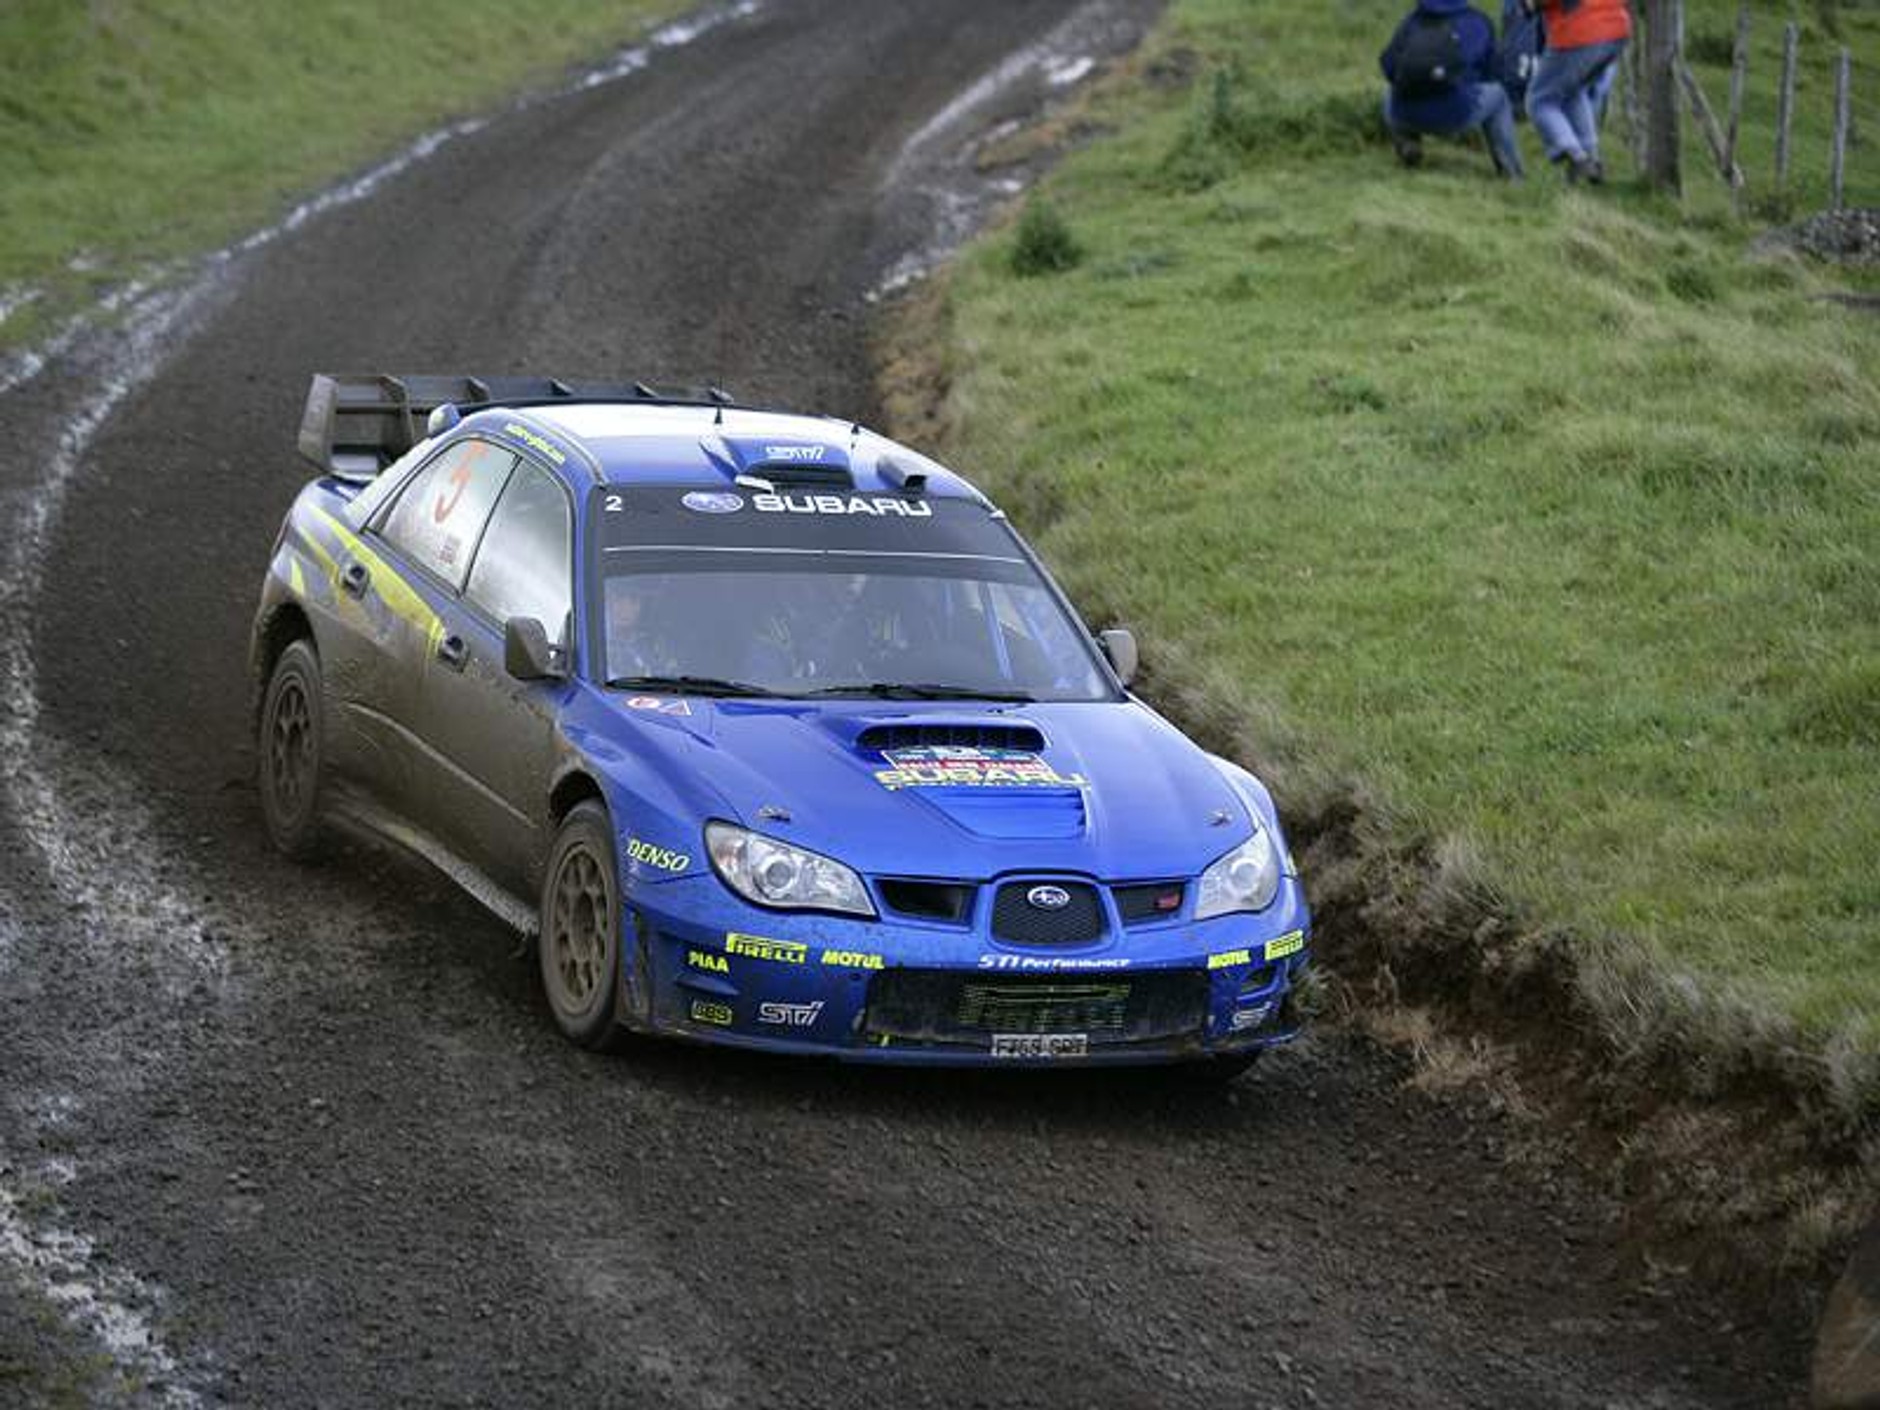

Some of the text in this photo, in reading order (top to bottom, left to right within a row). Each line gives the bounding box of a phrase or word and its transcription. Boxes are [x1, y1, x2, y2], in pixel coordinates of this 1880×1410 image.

[605, 497, 622, 512] 2
[752, 495, 931, 517] SUBARU
[626, 839, 690, 871] DENSO
[726, 933, 808, 963] PIRELLI
[688, 951, 730, 973] PIAA
[821, 950, 885, 969] MOTUL
